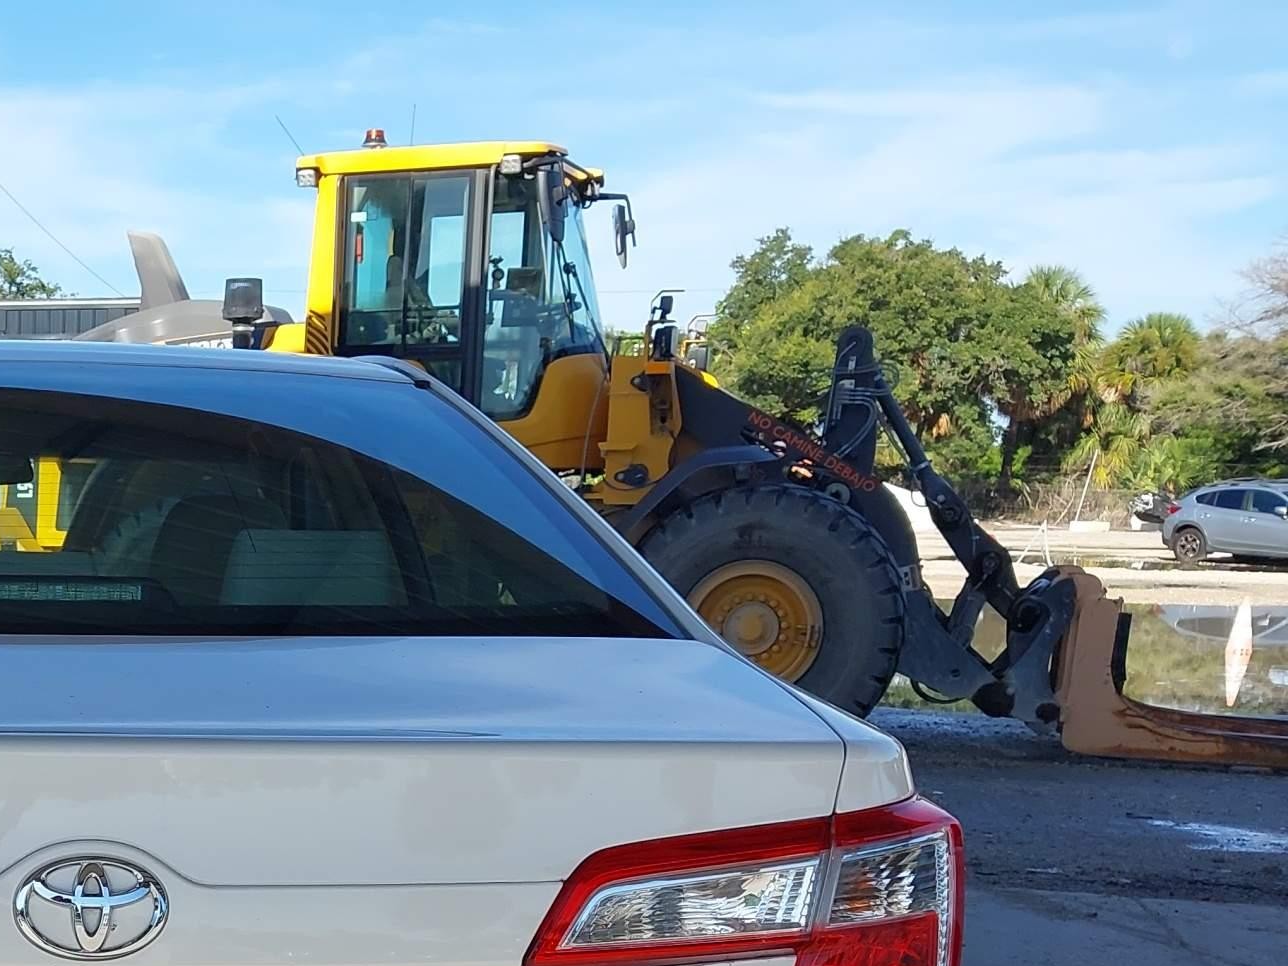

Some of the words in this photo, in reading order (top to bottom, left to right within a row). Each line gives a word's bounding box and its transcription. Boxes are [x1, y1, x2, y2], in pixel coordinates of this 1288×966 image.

[748, 411, 772, 429] NO
[773, 426, 823, 461] CAMINE
[824, 456, 875, 492] DEBAJO
